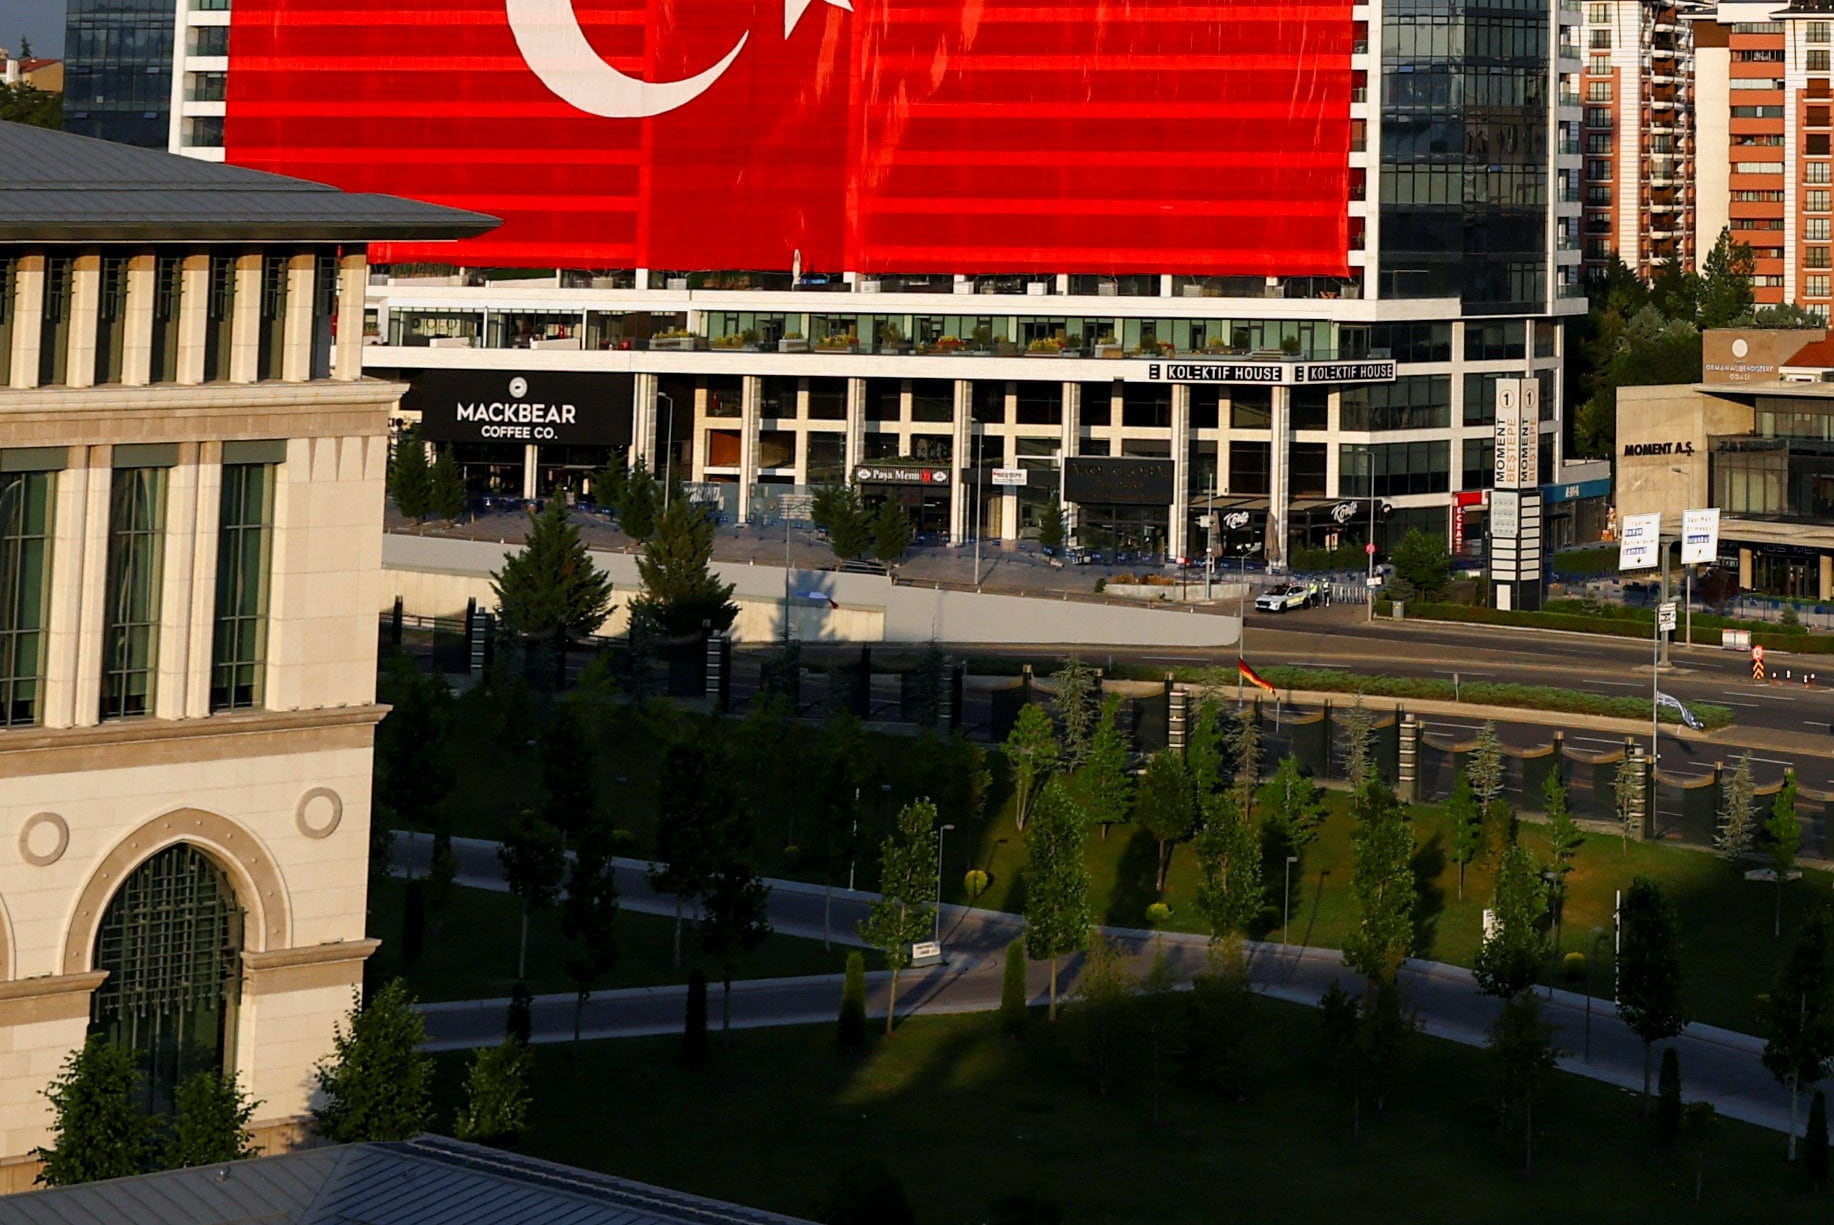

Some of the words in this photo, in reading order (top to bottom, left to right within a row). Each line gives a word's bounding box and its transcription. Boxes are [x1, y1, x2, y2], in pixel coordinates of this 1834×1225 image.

[1168, 366, 1230, 380] KOLEKTIF
[1235, 367, 1280, 381] HOUSE
[1311, 365, 1357, 380] KOLEKTIF
[1360, 364, 1393, 378] HOUSE
[456, 402, 577, 424] MACKBEAR
[481, 425, 530, 439] COFFEE
[533, 426, 559, 440] CO.
[1496, 417, 1506, 482] MOMENT
[1521, 417, 1529, 482] MOMENT
[1624, 442, 1673, 457] MOMENT
